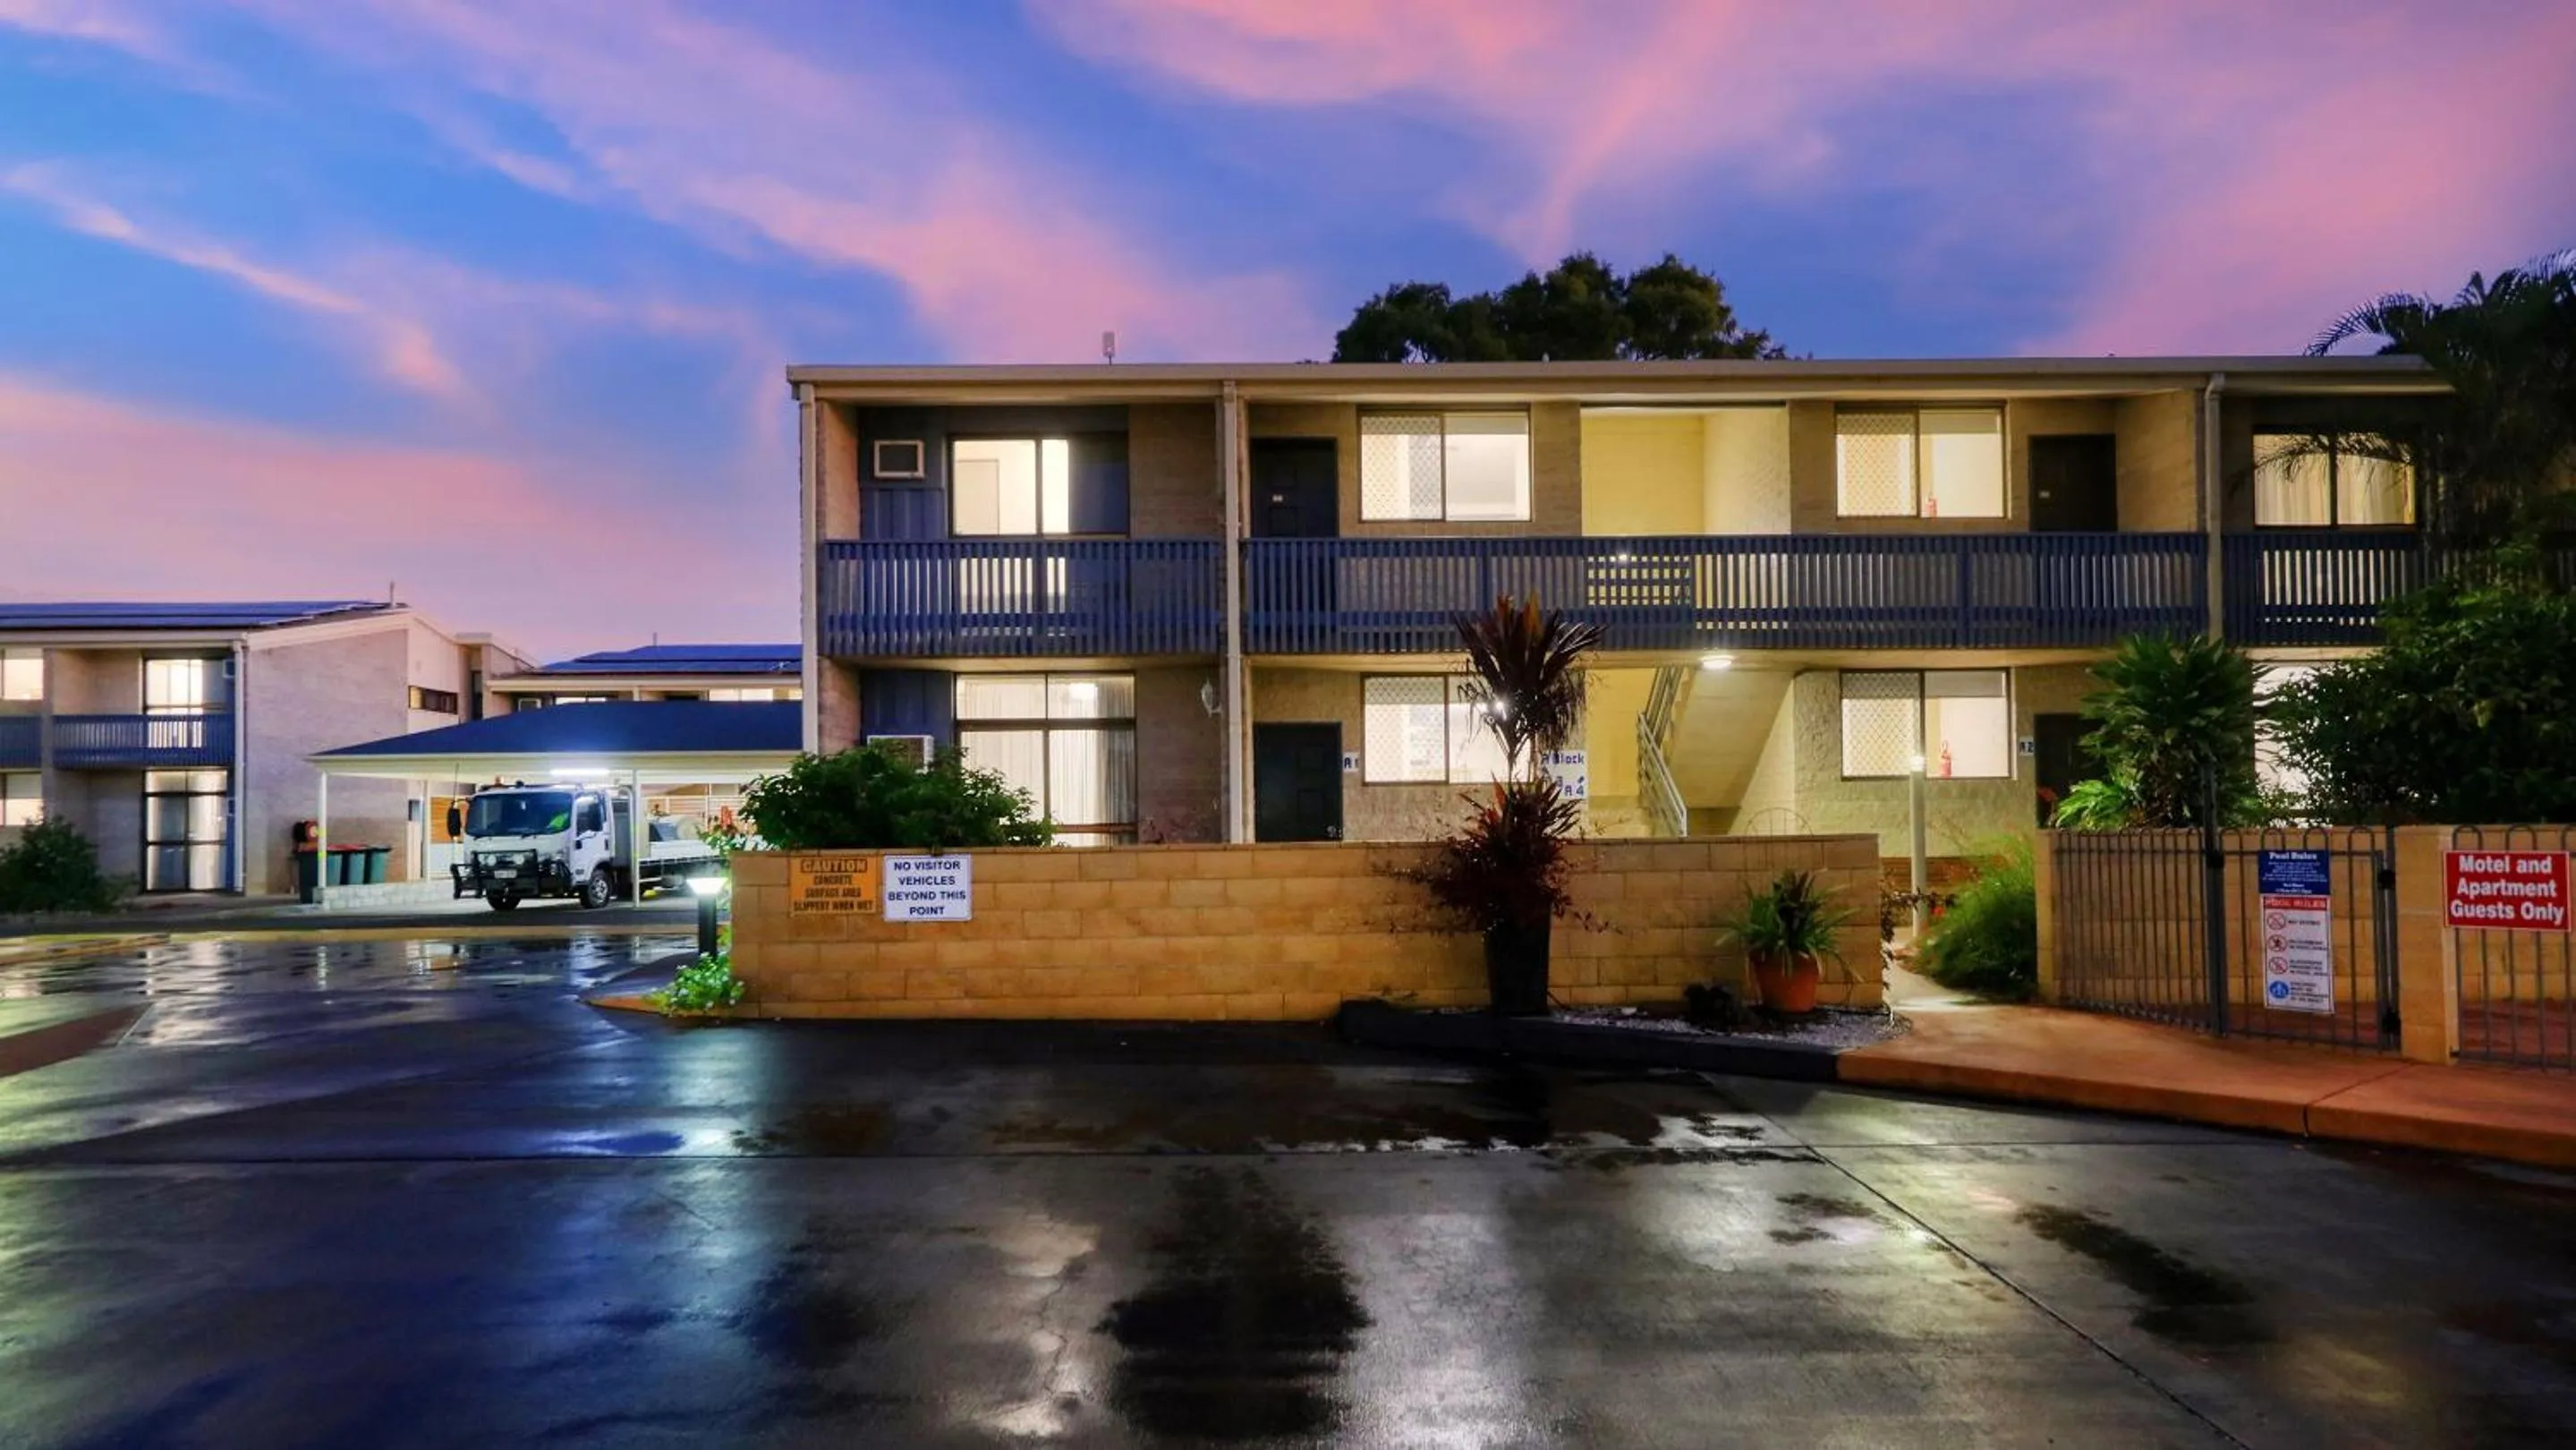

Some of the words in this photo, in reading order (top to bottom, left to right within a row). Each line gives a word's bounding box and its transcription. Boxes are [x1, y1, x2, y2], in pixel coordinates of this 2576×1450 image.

[2291, 851, 2317, 860] Rules
[802, 860, 867, 872] CAUTION
[894, 861, 911, 871] NO
[914, 860, 961, 871] VISITOR
[2459, 855, 2510, 874] Motel
[2516, 855, 2553, 874] and
[813, 874, 852, 885] CONCRETE
[898, 876, 956, 886] VEHICLES
[2457, 877, 2557, 900] Apartment
[888, 891, 936, 901] BEYOND
[940, 891, 966, 900] THIS
[793, 900, 829, 912] SLIPPERY
[832, 900, 854, 911] WHEN
[910, 906, 945, 916] POINT
[2450, 900, 2515, 919] Guests
[2521, 900, 2564, 925] Only
